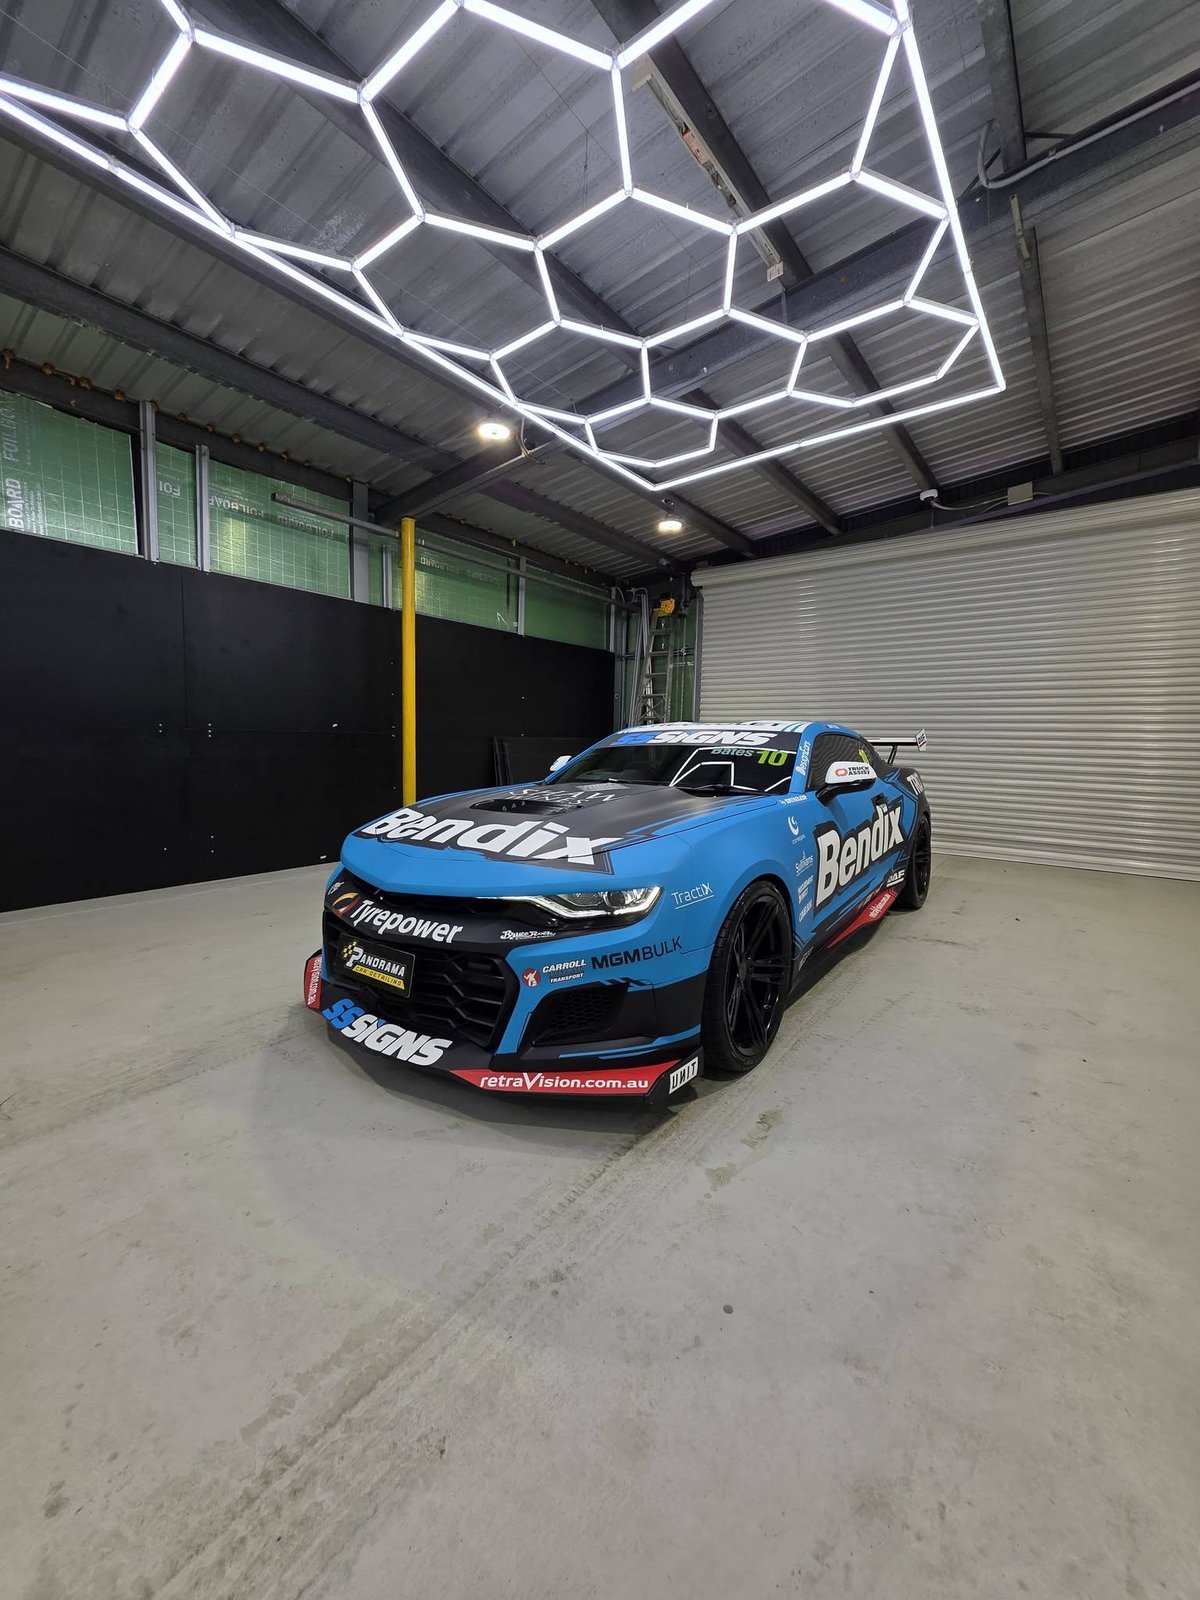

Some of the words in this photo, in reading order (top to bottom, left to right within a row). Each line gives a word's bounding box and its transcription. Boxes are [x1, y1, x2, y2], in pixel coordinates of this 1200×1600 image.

[756, 749, 789, 766] 10
[362, 807, 624, 865] Bendix
[815, 803, 904, 907] Bendix
[350, 900, 463, 943] Tyrepower
[345, 946, 406, 977] PANORAMA
[542, 959, 587, 973] CARROLL
[550, 973, 584, 983] TRANSPORT
[479, 1072, 649, 1090] retraVision.com.au
